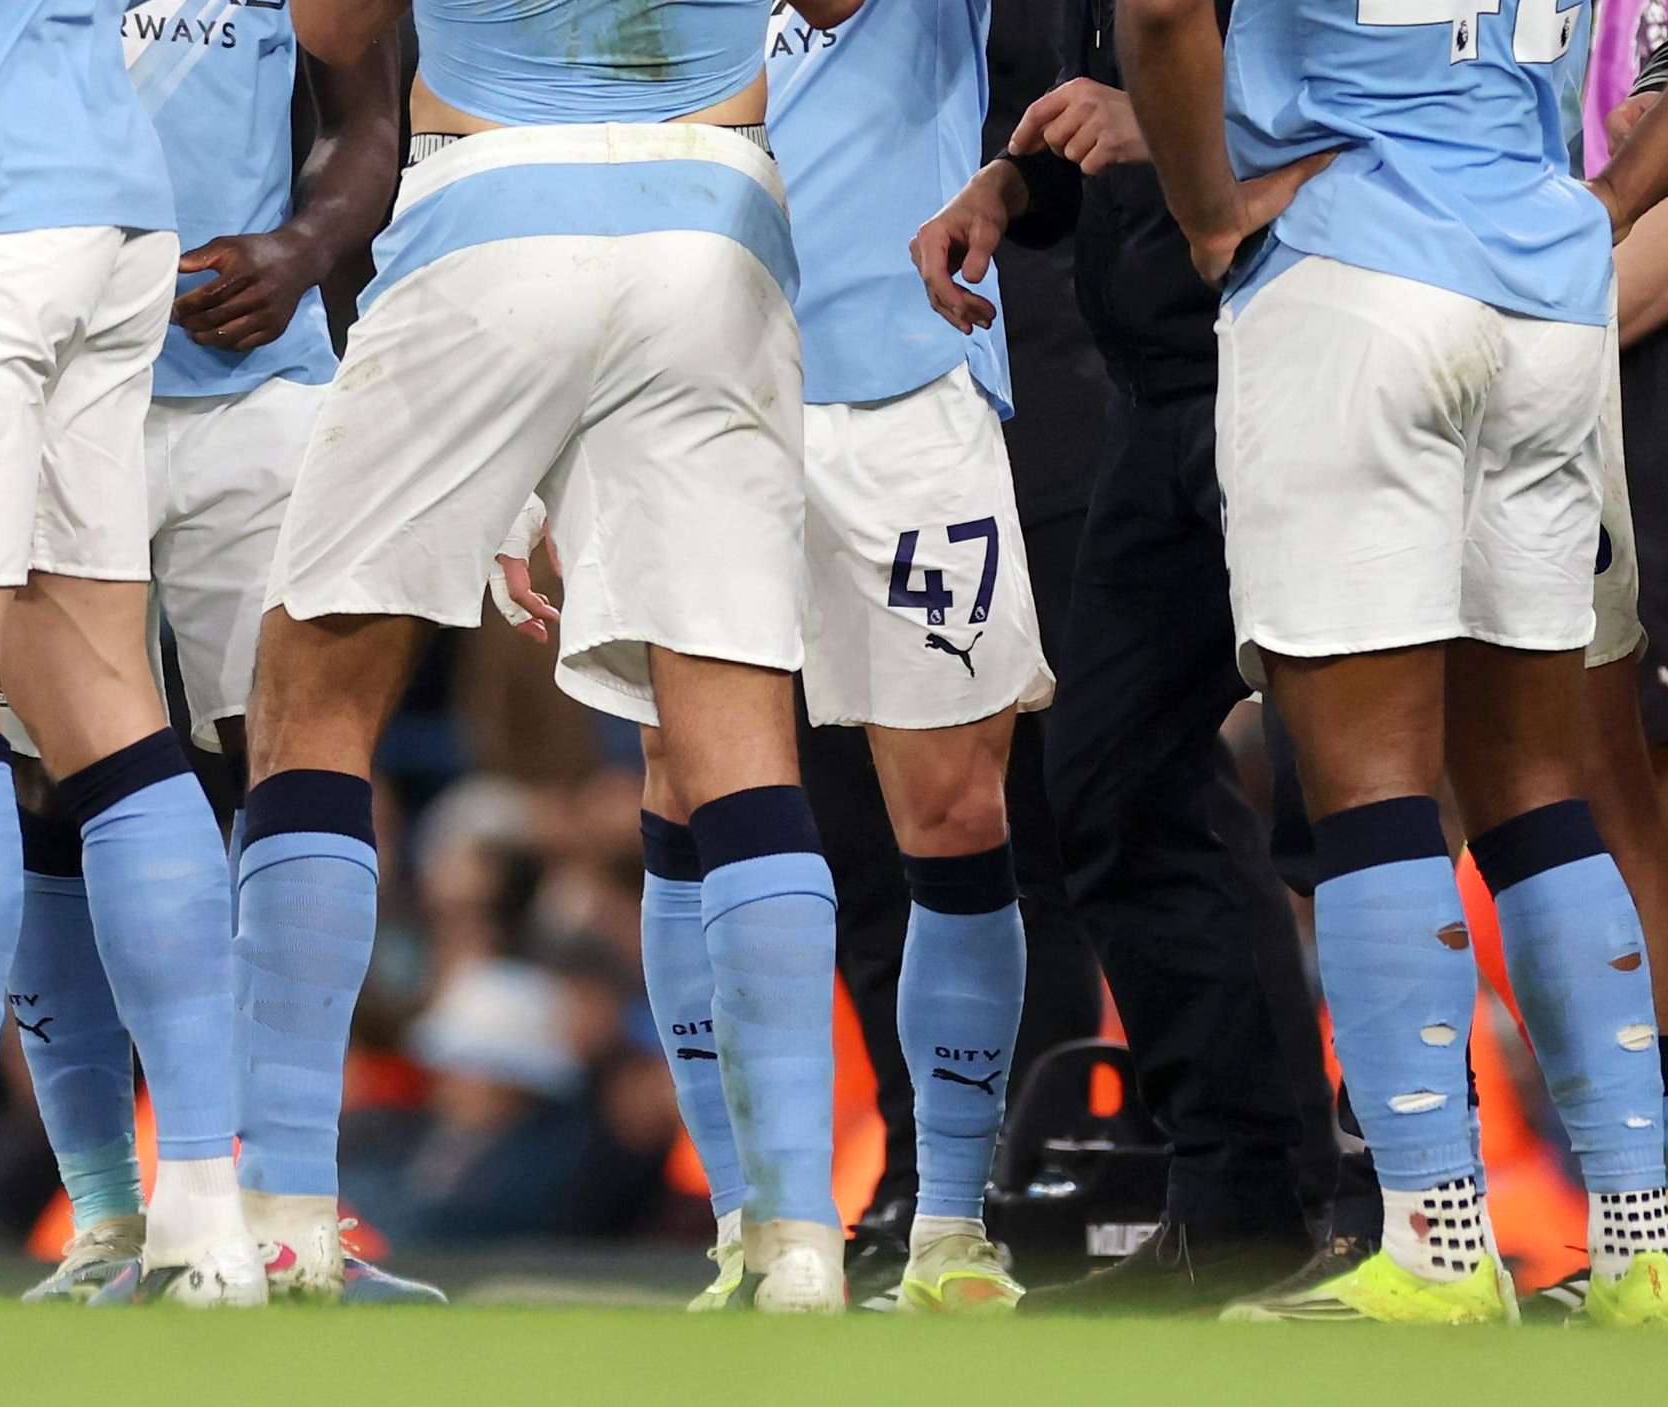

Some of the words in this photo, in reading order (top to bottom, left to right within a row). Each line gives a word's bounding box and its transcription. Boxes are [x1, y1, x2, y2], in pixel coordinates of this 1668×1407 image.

[887, 515, 999, 627] 47
[672, 1019, 714, 1036] CIT
[934, 1046, 1001, 1062] CITY
